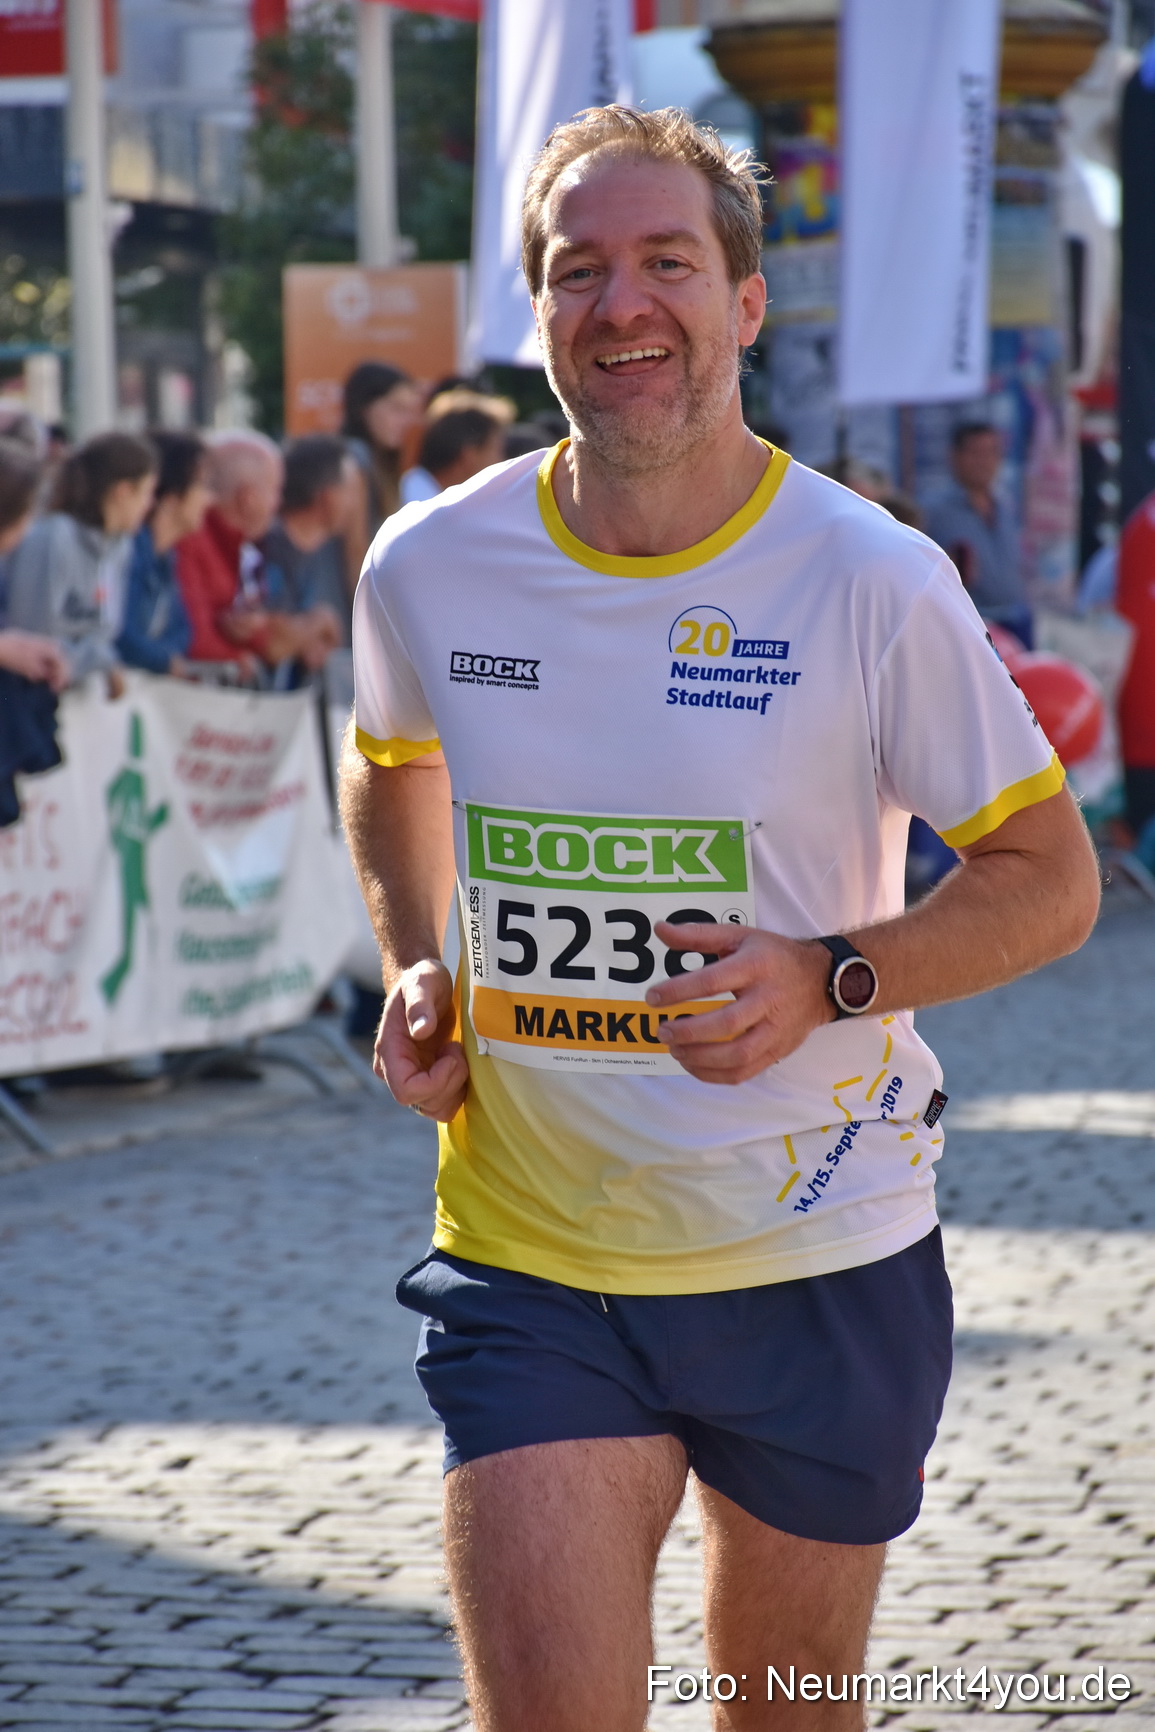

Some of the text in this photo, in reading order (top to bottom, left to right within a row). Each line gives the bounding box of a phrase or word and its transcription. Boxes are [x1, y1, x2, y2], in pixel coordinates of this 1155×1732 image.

[675, 619, 784, 657] 20 JAHRE
[449, 674, 539, 691] inspired by smart concepts
[450, 651, 541, 682] BOCK
[670, 661, 801, 685] Neumarkter
[666, 687, 773, 715] Stadtlauf
[482, 815, 728, 884] BOCK
[514, 1004, 697, 1044] MARKU
[793, 1168, 833, 1213] 14./15.
[880, 1076, 903, 1114] 2019
